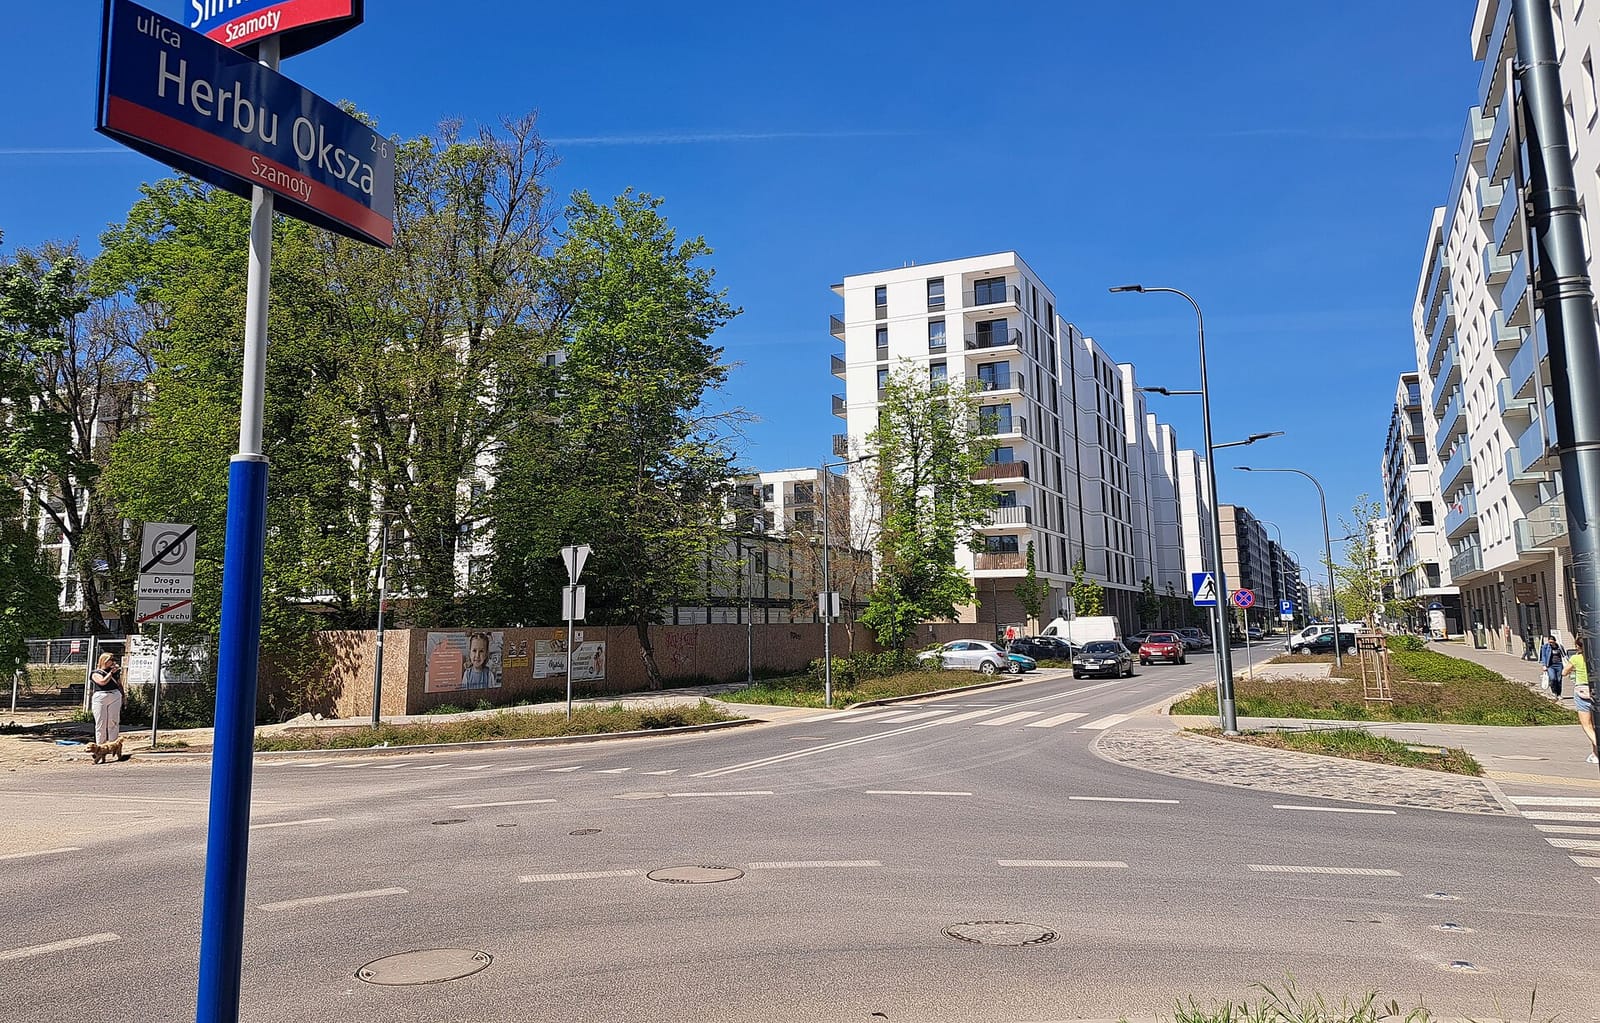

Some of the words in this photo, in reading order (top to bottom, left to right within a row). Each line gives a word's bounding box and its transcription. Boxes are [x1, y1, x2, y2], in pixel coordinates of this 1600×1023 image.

[137, 15, 182, 49] ulica
[225, 10, 281, 43] Szamoty
[157, 51, 278, 146] Herbu
[292, 117, 375, 196] Oksza
[370, 135, 388, 159] 2-6
[250, 156, 313, 202] Szamoty
[141, 587, 191, 595] wewnętrzna
[154, 576, 180, 586] Droga
[167, 612, 190, 620] ruchu
[1282, 601, 1290, 611] P
